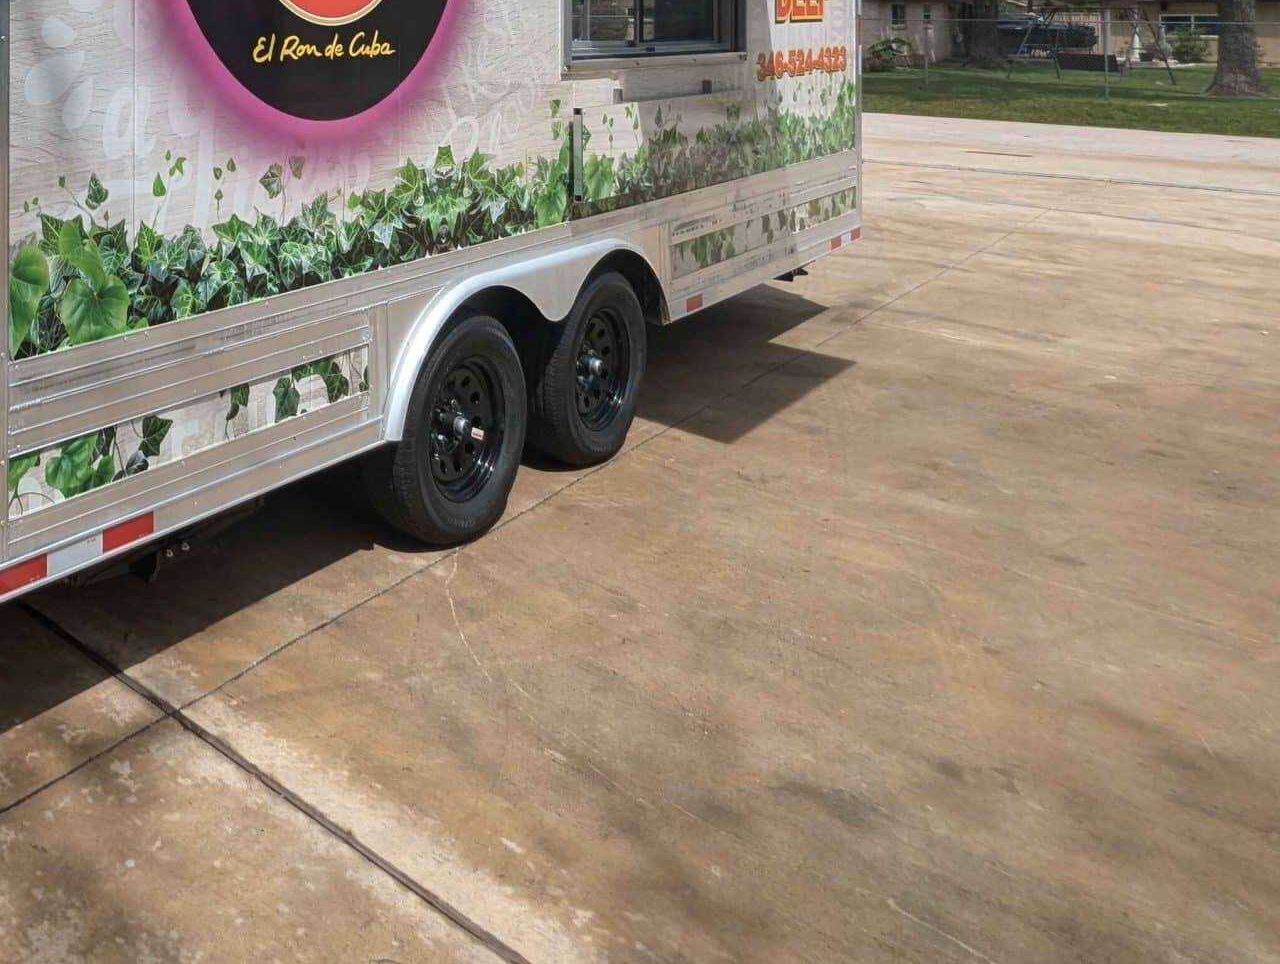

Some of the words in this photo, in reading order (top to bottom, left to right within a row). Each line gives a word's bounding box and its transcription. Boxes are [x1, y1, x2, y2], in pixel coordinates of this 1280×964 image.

[252, 33, 275, 64] El
[280, 35, 323, 62] Ron
[324, 32, 344, 58] de
[349, 29, 396, 58] Cuba
[756, 47, 848, 81] 346-524-4323
